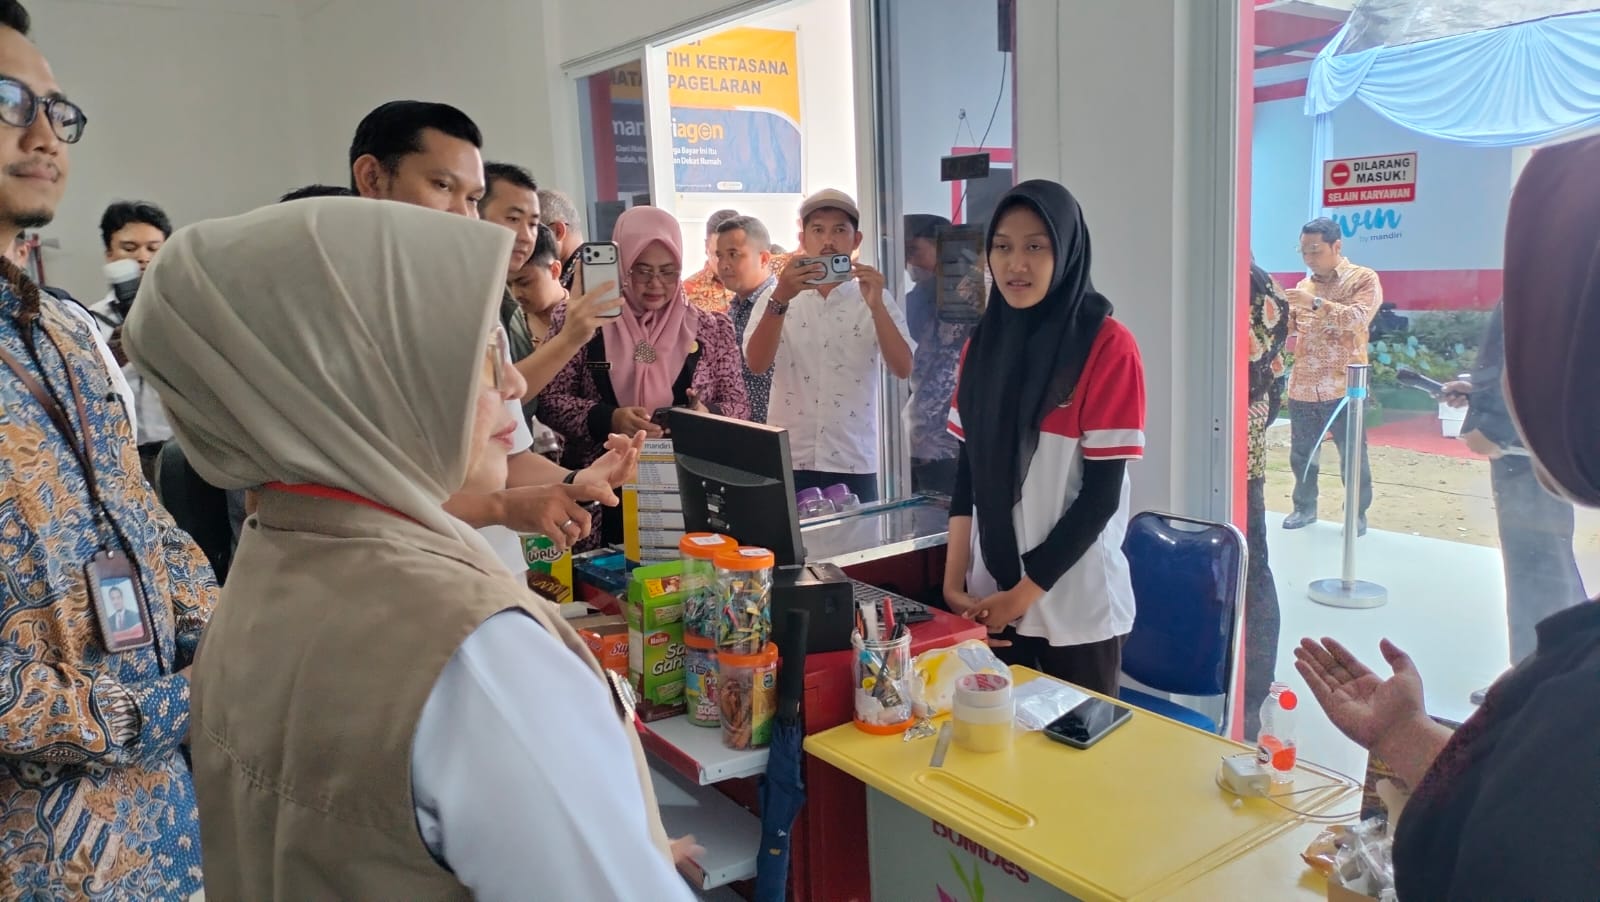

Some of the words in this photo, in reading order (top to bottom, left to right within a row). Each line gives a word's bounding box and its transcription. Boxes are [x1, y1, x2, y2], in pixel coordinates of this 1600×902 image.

[696, 54, 789, 75] KERTASANA
[668, 74, 762, 94] PAGELARAN
[681, 156, 700, 165] Dekat
[700, 157, 722, 166] Rumah
[1353, 158, 1411, 171] DILARANG
[1356, 170, 1407, 183] MASUK!
[1327, 191, 1359, 202] SELAIN
[1360, 188, 1411, 201] KARYAWAN
[1370, 231, 1402, 241] mandiri
[644, 442, 672, 450] mandiri
